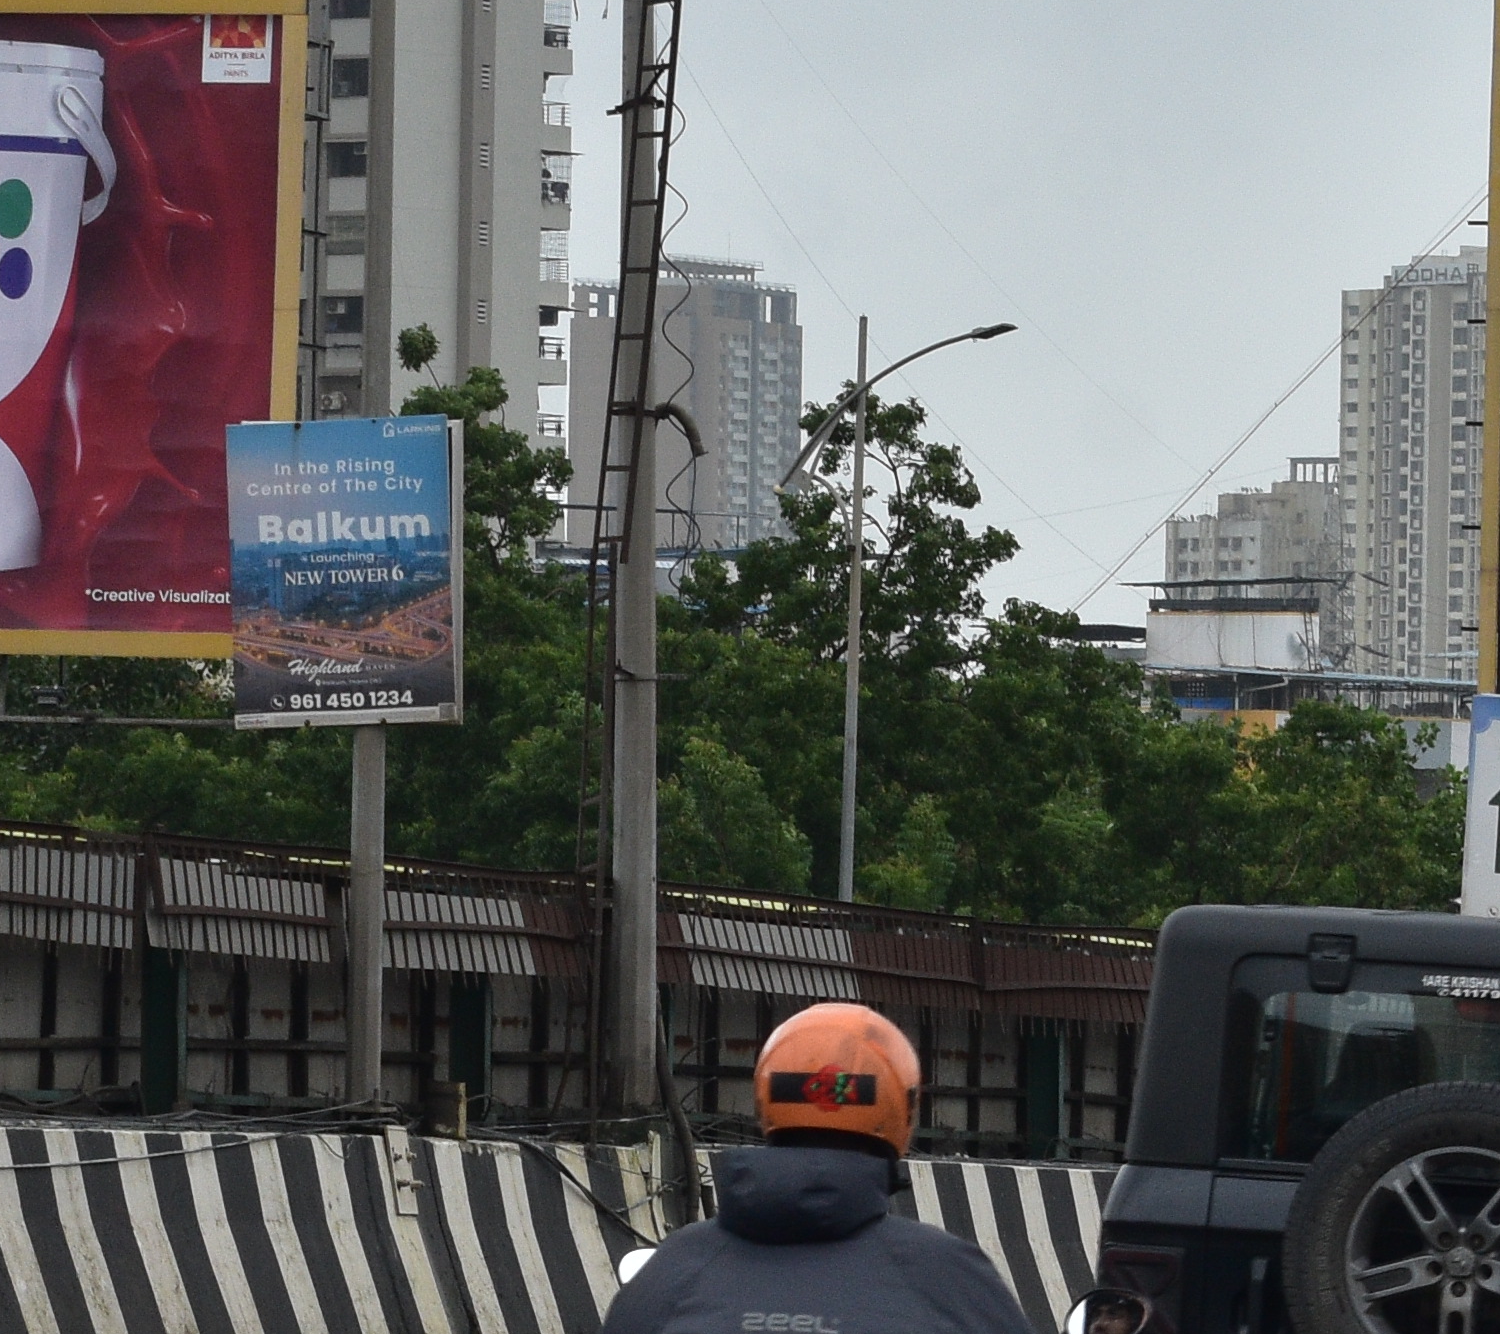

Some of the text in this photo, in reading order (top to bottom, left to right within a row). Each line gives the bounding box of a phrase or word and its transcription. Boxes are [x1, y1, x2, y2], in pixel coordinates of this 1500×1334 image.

[209, 51, 266, 60] ADITYA BIRLA
[1393, 267, 1464, 283] LODHA
[274, 457, 396, 478] In the Rising
[246, 473, 425, 498] Centre of The City
[257, 510, 432, 545] Balkum
[309, 550, 375, 566] Launching
[284, 564, 405, 587] NEW TOWER 6
[287, 657, 364, 683] Highland
[289, 689, 414, 710] 961 450 1234
